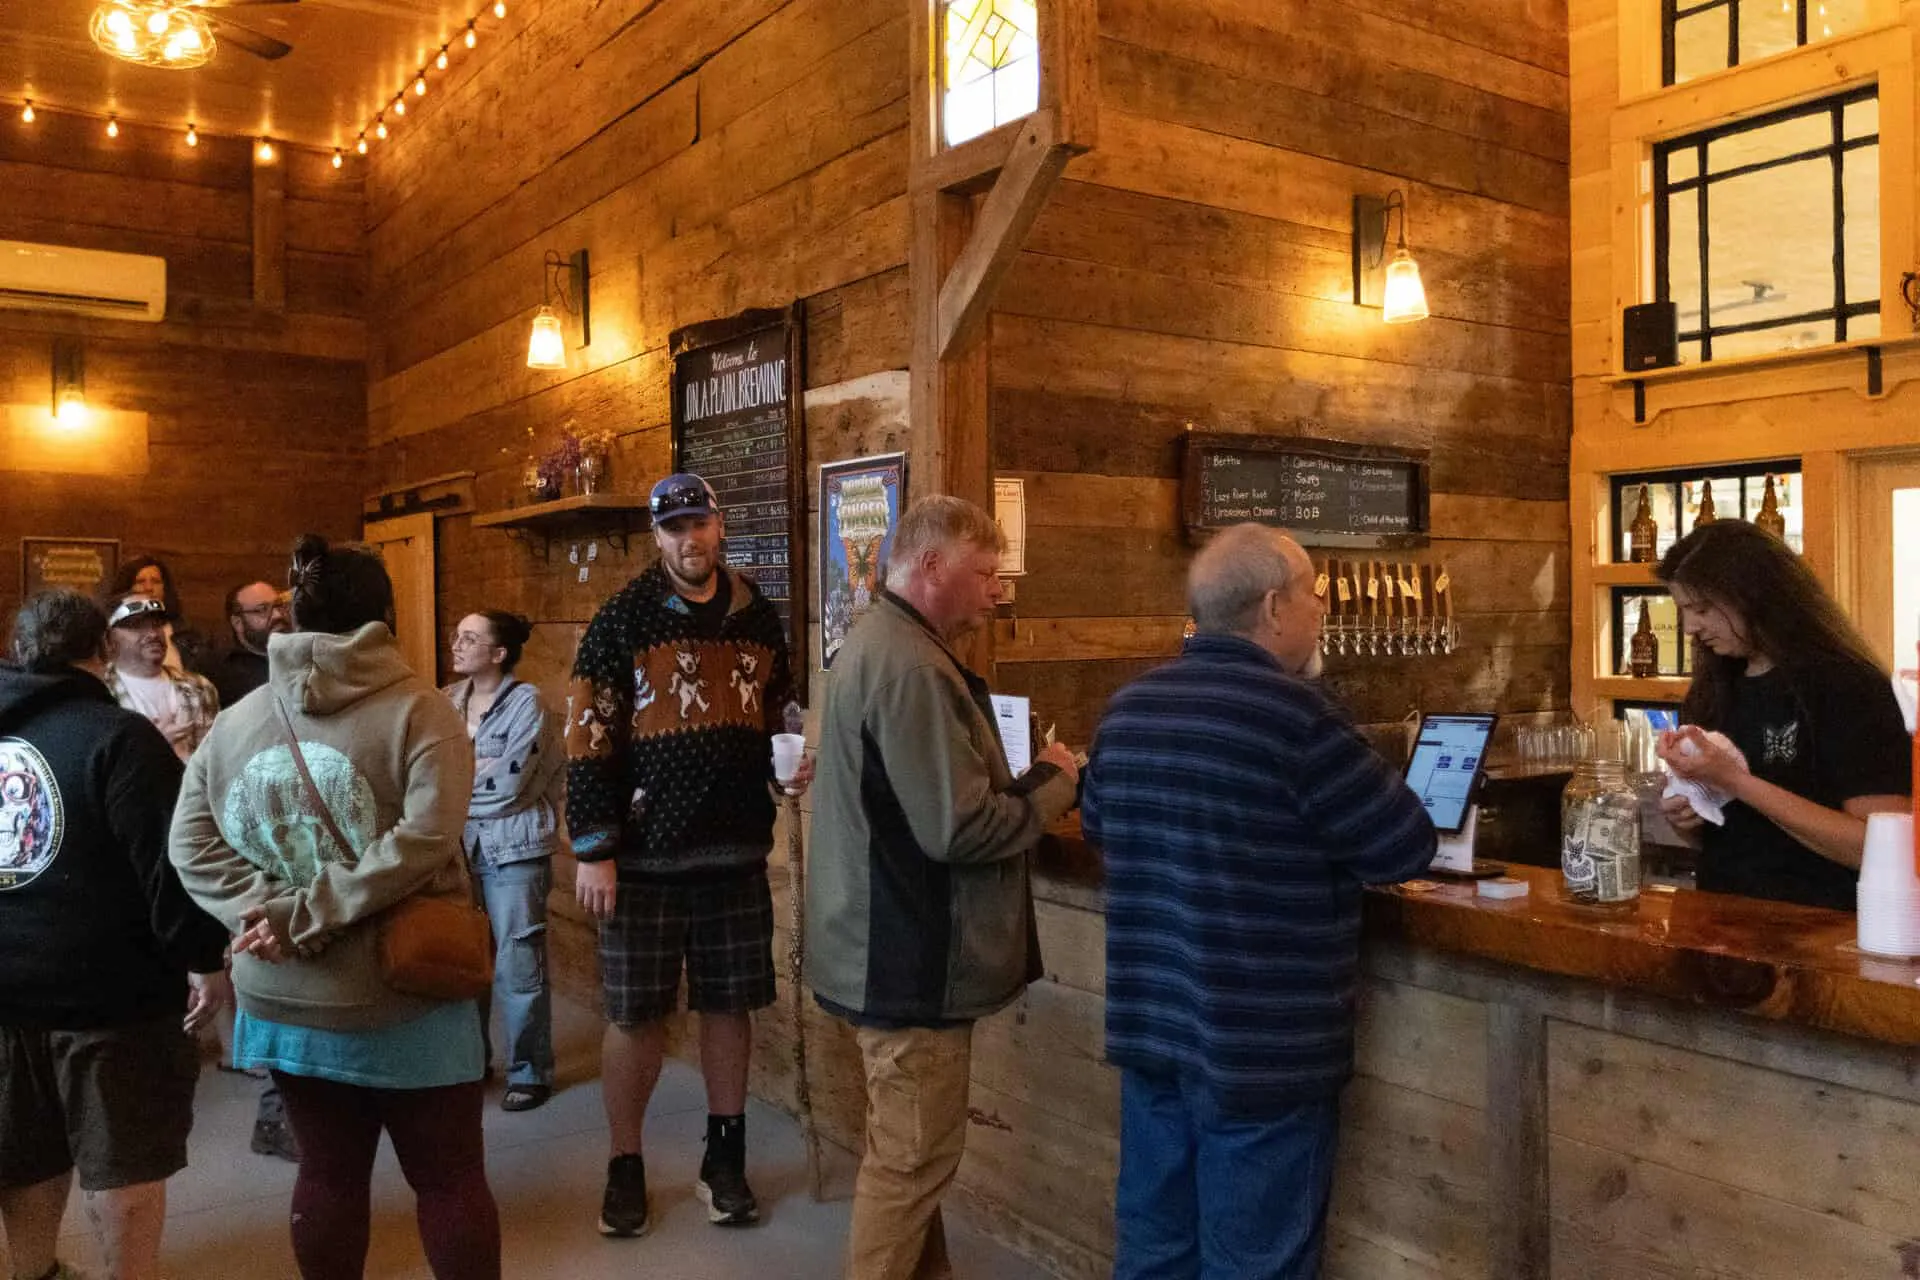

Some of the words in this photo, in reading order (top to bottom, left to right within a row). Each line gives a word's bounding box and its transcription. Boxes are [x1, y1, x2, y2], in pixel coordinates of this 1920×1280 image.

[748, 340, 759, 361] to
[685, 381, 700, 422] ON
[700, 379, 710, 419] A
[710, 372, 736, 417] PLAIN
